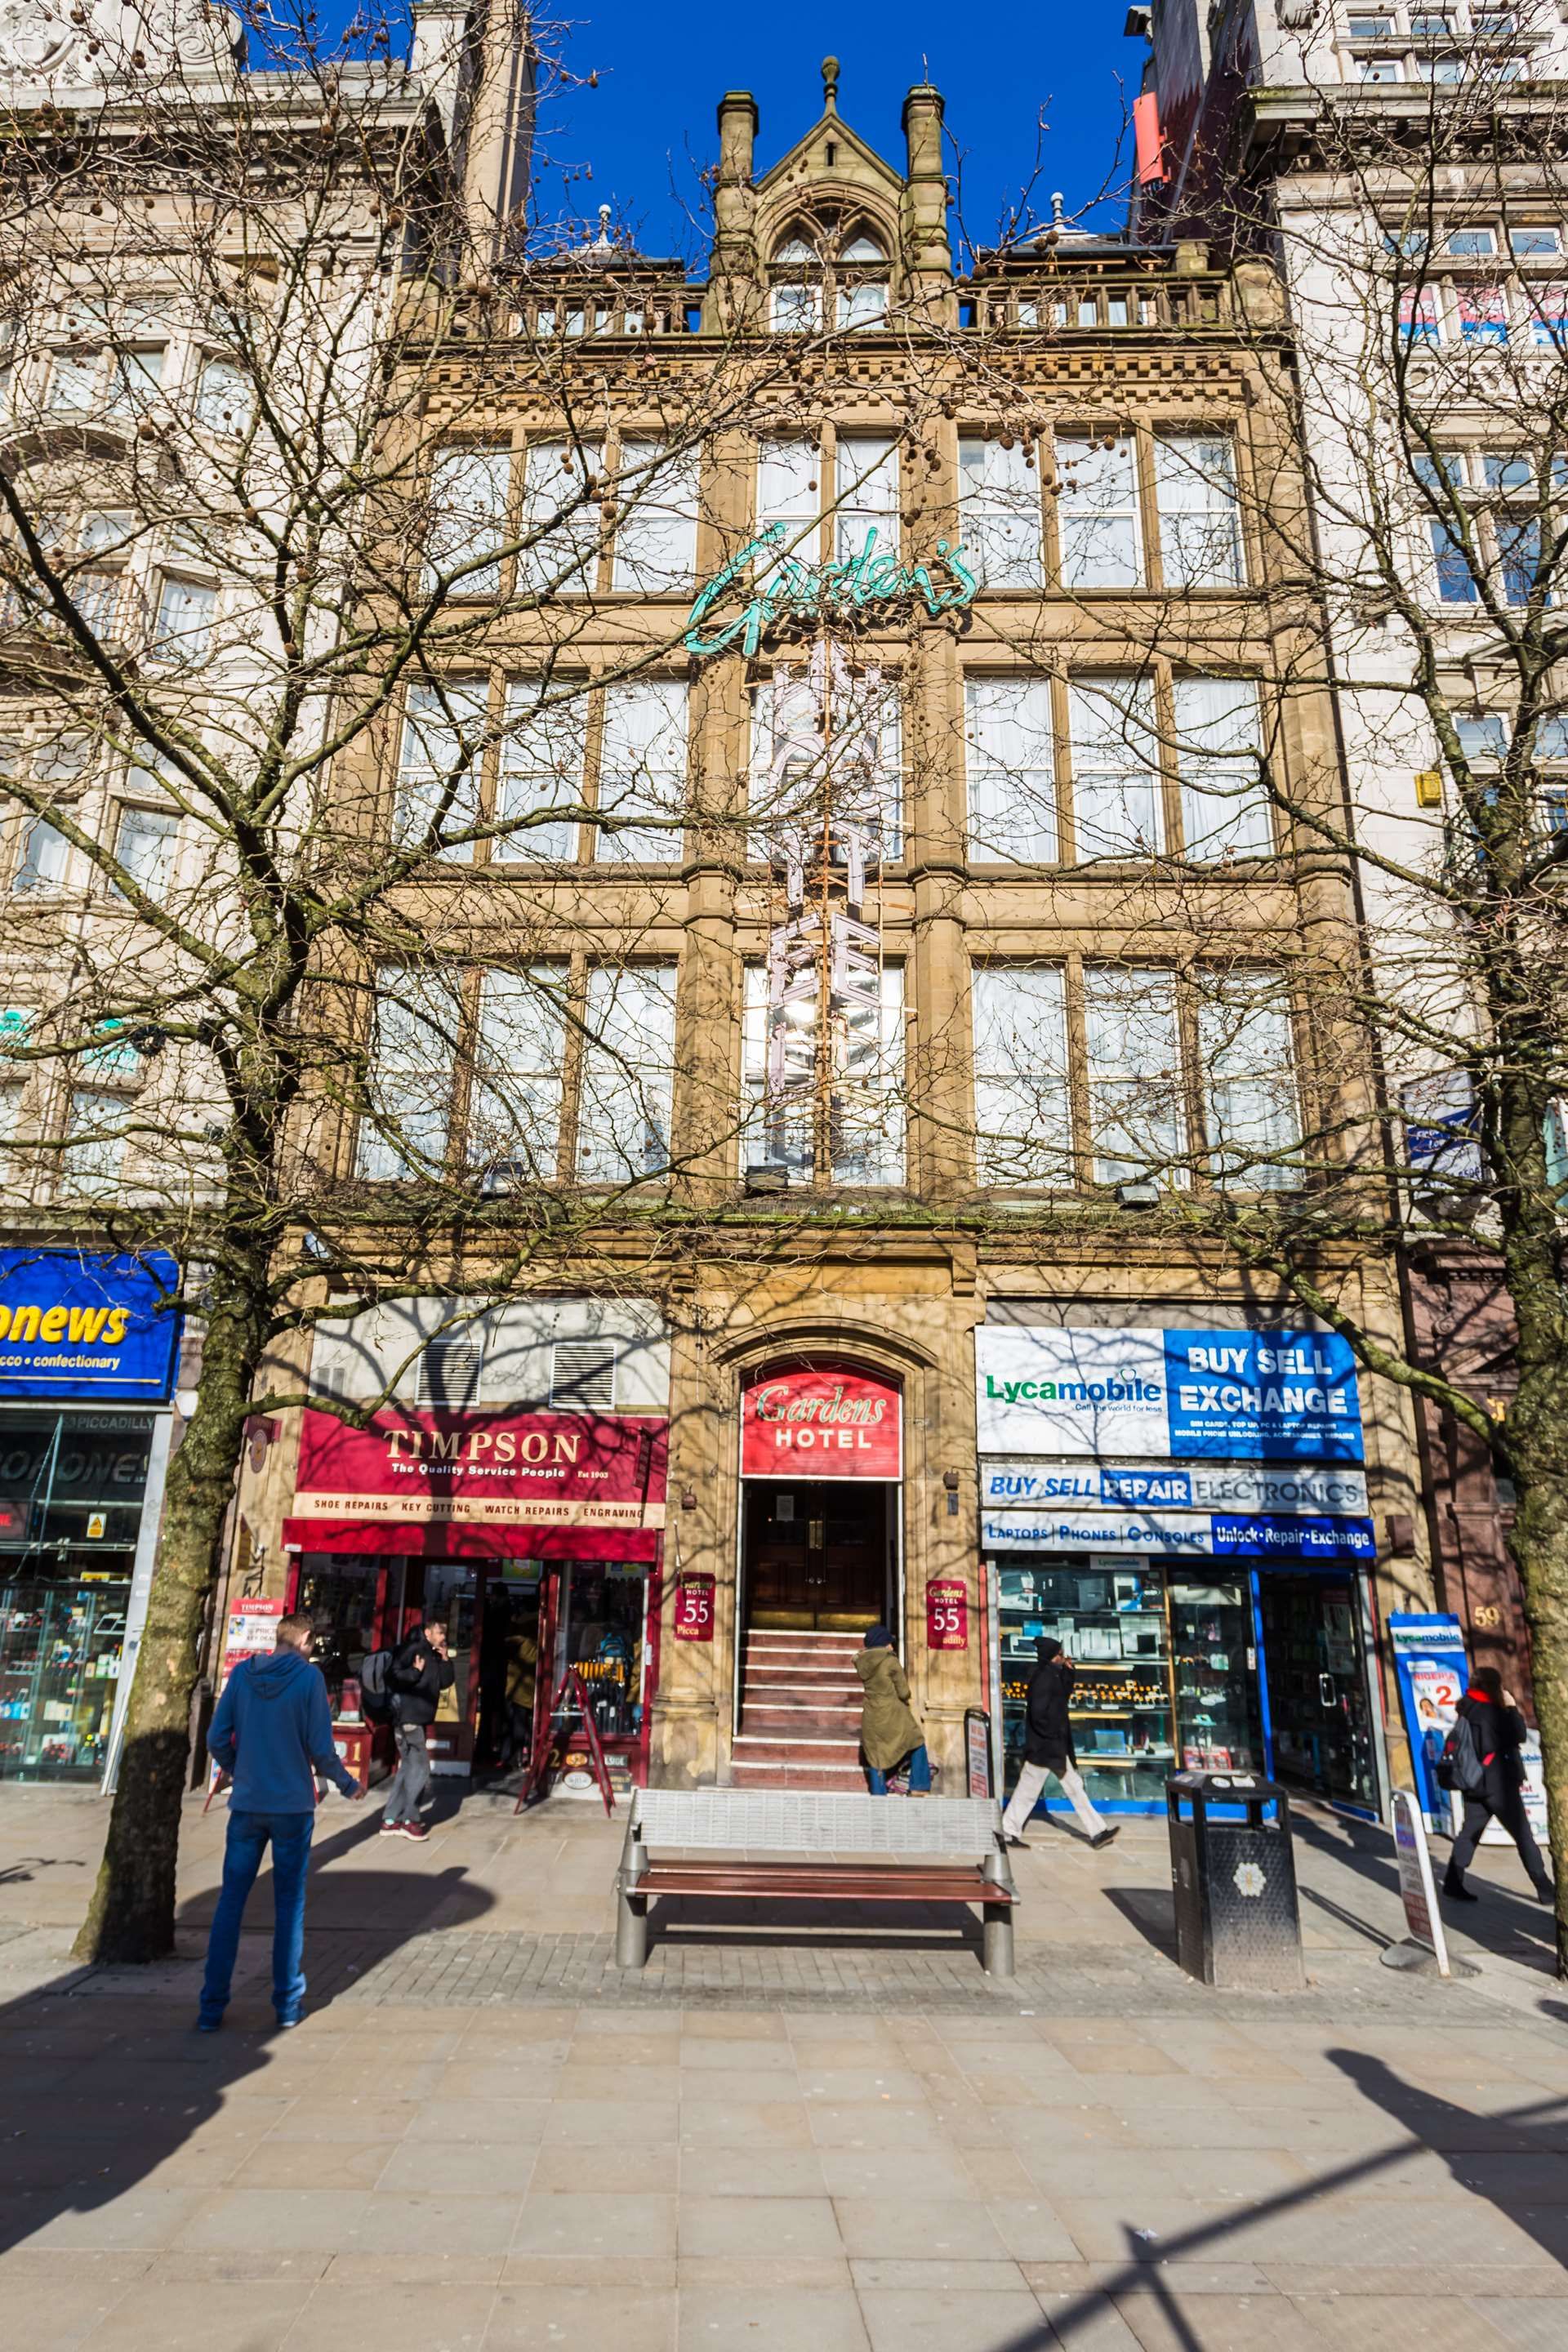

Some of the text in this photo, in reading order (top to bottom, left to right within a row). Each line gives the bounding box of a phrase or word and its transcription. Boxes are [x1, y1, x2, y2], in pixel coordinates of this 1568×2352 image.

[33, 1354, 120, 1371] confectionary
[1187, 1347, 1333, 1375] BUY SELL
[987, 1370, 1162, 1404] Lycamobile
[756, 1385, 888, 1423] Gardens
[1075, 1403, 1091, 1412] Call
[1108, 1404, 1131, 1413] world
[1133, 1405, 1144, 1413] for
[1178, 1385, 1348, 1414] EXCHANGE
[78, 1417, 155, 1430] PICCADILLY
[1232, 1421, 1246, 1429] TOP
[1278, 1422, 1306, 1430] LAPTOP
[384, 1430, 581, 1464] TIMPSON
[775, 1428, 873, 1450] HOTEL
[392, 1463, 416, 1475] The
[418, 1464, 464, 1477] Quality
[468, 1464, 517, 1477] Service
[521, 1467, 566, 1480] People
[577, 1470, 589, 1479] Est
[989, 1476, 1360, 1503] BUY SELL REPAIR ELECTRONICS
[314, 1499, 644, 1519] SHOE REPAIRS KEY CUTTING WATCH REPAIRS ENGRAVING
[1216, 1526, 1370, 1548] Unlock Repair Exchange
[240, 1603, 274, 1611] TIMPSON
[683, 1598, 709, 1624] 55
[1474, 1606, 1500, 1628] 59
[676, 1624, 699, 1635] Picca
[933, 1607, 960, 1632] 55
[942, 1634, 966, 1647] adilly
[1395, 1632, 1460, 1644] Lycamobile
[1413, 1672, 1456, 1681] NIGERIA
[1436, 1685, 1456, 1707] 2
